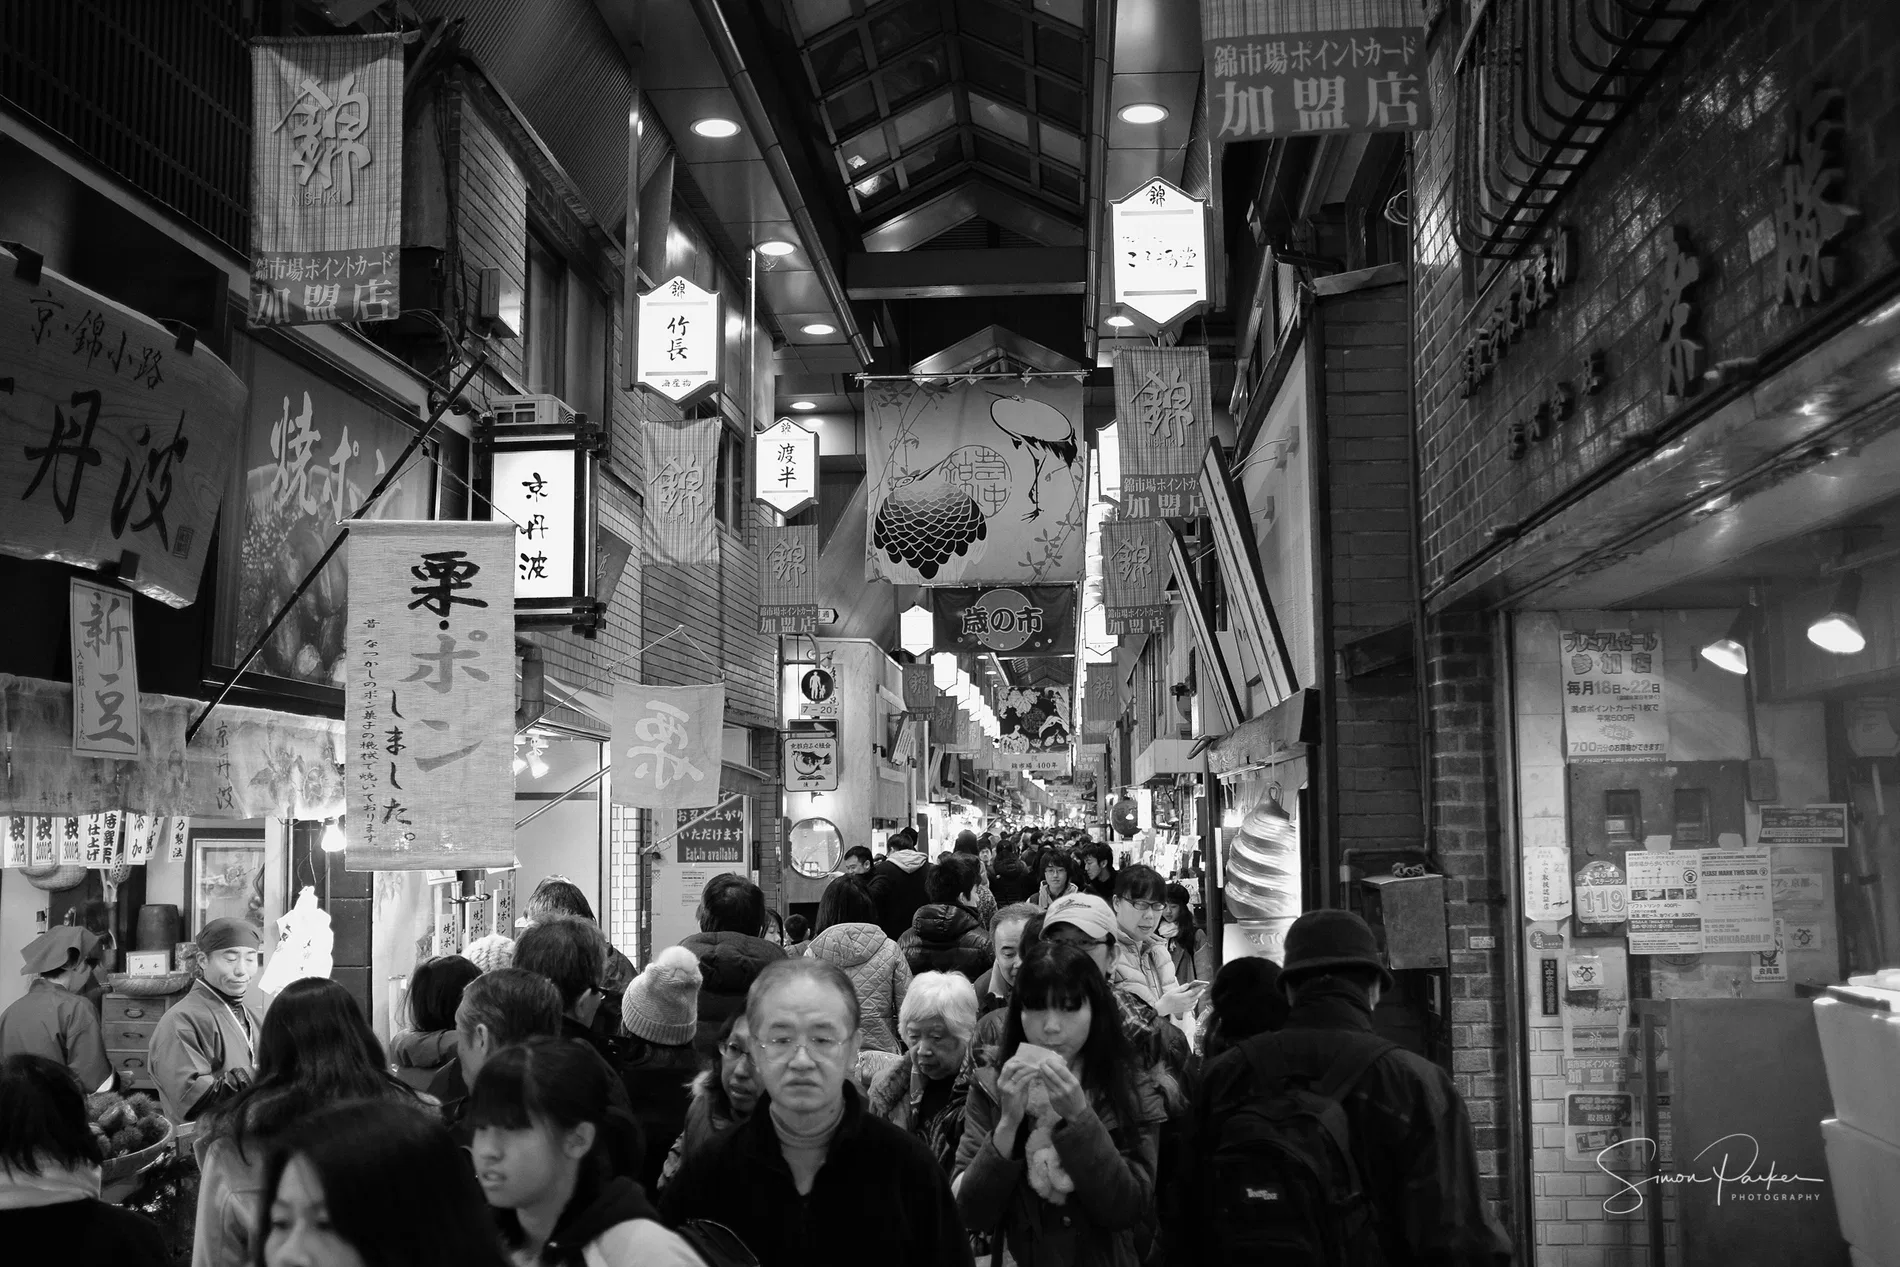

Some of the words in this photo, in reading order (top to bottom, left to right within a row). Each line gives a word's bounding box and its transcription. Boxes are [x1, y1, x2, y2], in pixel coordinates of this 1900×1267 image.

[1213, 34, 1417, 78] 錦市場ポイントカード
[1215, 70, 1421, 138] 加盟店
[271, 72, 373, 206] 錦
[290, 189, 343, 207] NISHIKI
[255, 251, 394, 282] 錦市場ポイントカード
[255, 279, 393, 325] 加盟店
[667, 315, 690, 361] 竹長
[1130, 367, 1195, 447] 錦
[21, 390, 190, 552] 丹波
[650, 452, 705, 524] 錦
[777, 443, 797, 488] 渡半
[1123, 477, 1200, 493] 錦市場ポイントカ
[518, 472, 549, 580] 京丹波
[766, 535, 807, 588] 錦
[1110, 535, 1152, 588] 錦
[759, 606, 816, 617] 錦市場ポイントカード
[759, 616, 817, 634] 加盟店
[961, 605, 1044, 635] 歳の市
[1107, 617, 1165, 634] 加盟店
[1563, 632, 1659, 654] プレミアムセール
[1571, 653, 1653, 676] 参加店
[80, 591, 135, 746] 新豆
[215, 720, 235, 811] 京丹波
[381, 689, 416, 842] しました。
[627, 700, 705, 790] 栗
[679, 828, 744, 842] いただけます
[707, 847, 739, 861] available
[1580, 888, 1626, 914] 119
[1568, 1069, 1627, 1084] 加盟店
